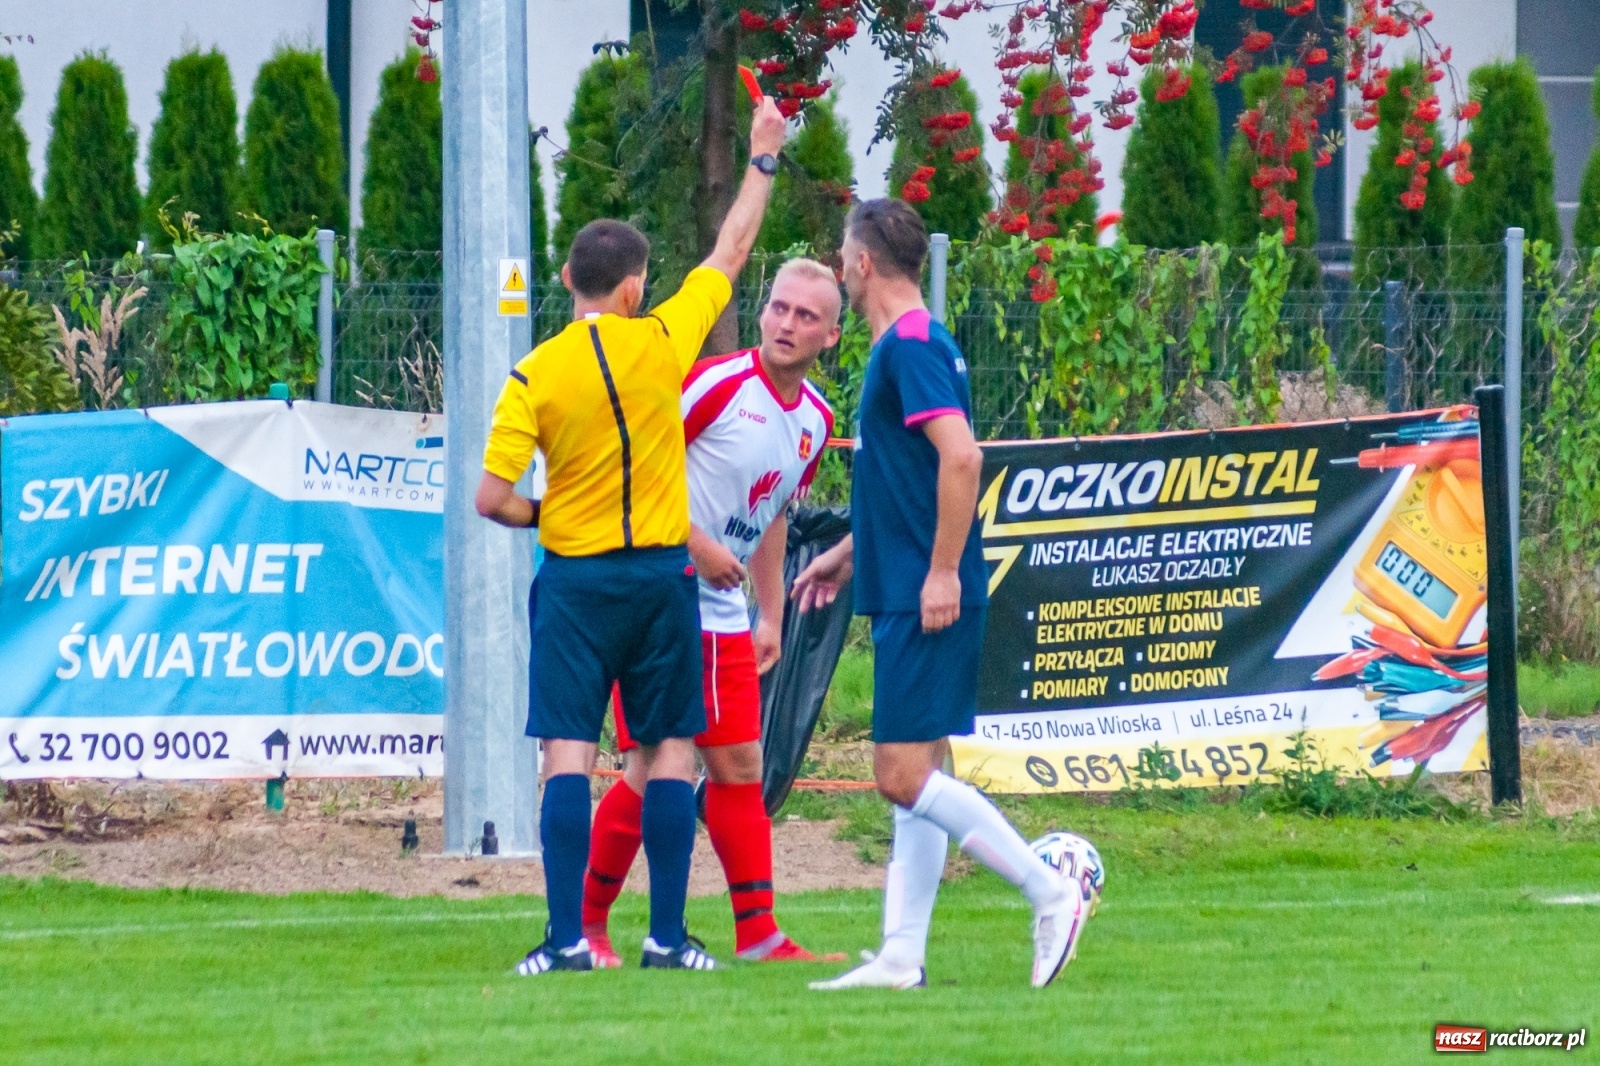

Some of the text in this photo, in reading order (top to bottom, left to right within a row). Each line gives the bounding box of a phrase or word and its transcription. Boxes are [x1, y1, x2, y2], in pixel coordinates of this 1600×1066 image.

[19, 469, 169, 522] SZYBKI
[1006, 447, 1320, 514] OCZKOINSTAL
[1029, 522, 1313, 566] INSTALACJE ELEKTRYCZNE
[25, 543, 324, 601] INTERNET
[1092, 555, 1246, 587] ŁUKASZ OCZADŁY
[1038, 586, 1262, 622] KOMPLEKSOWE INSTALACJE
[1036, 611, 1224, 644] ELEKTRYCZNE W DOMU
[1034, 640, 1217, 673] PRZYŁĄCZA UZIOMY
[1032, 666, 1230, 700] POMIARY DOMOFONY
[982, 702, 1294, 741] 47-450 Nowa Wioska ul. Leśna 24
[39, 731, 229, 761] 32 700 9002
[1064, 753, 1130, 785] 661
[1205, 742, 1275, 777] 852
